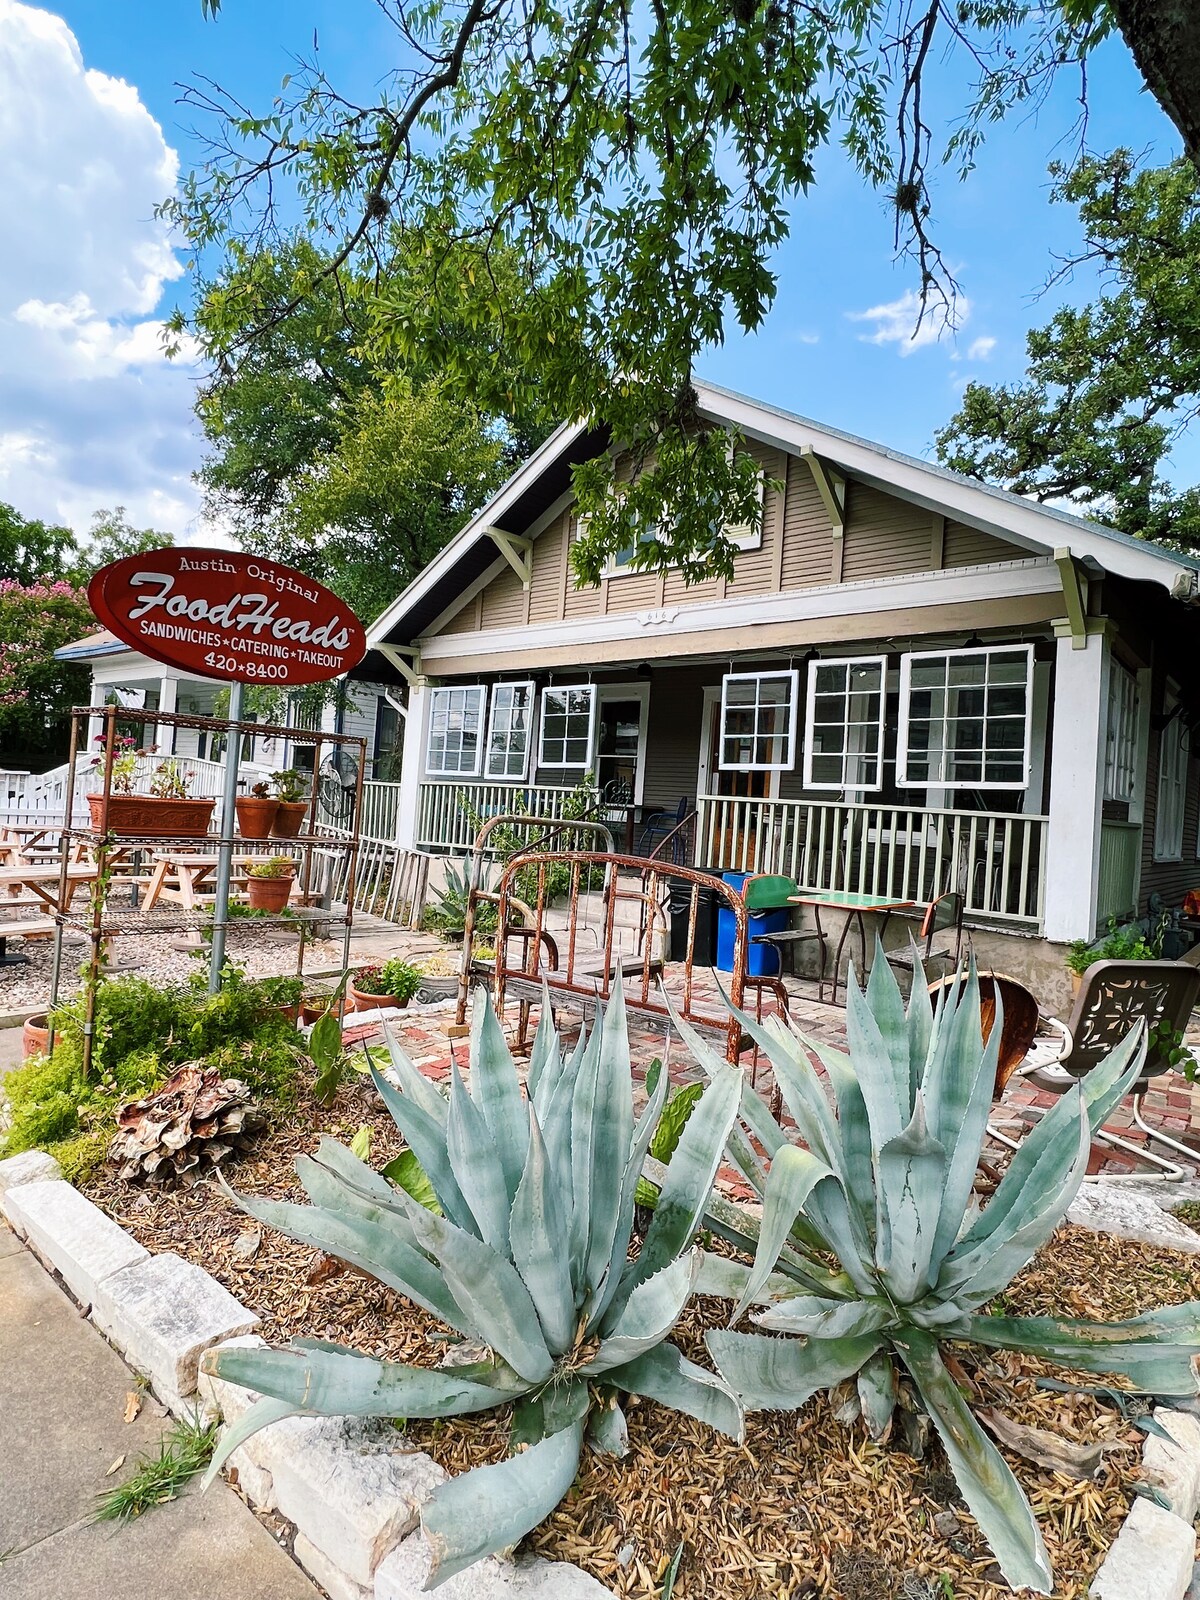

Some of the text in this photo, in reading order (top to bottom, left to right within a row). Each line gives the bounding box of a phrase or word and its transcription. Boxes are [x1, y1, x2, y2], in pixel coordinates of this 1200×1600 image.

[179, 557, 320, 604] Austin Original
[128, 571, 351, 650] FoodHeads
[647, 611, 666, 620] 616
[140, 620, 344, 669] SANDWICHES CATERING TAKEOUT
[204, 651, 288, 679] 420 8400
